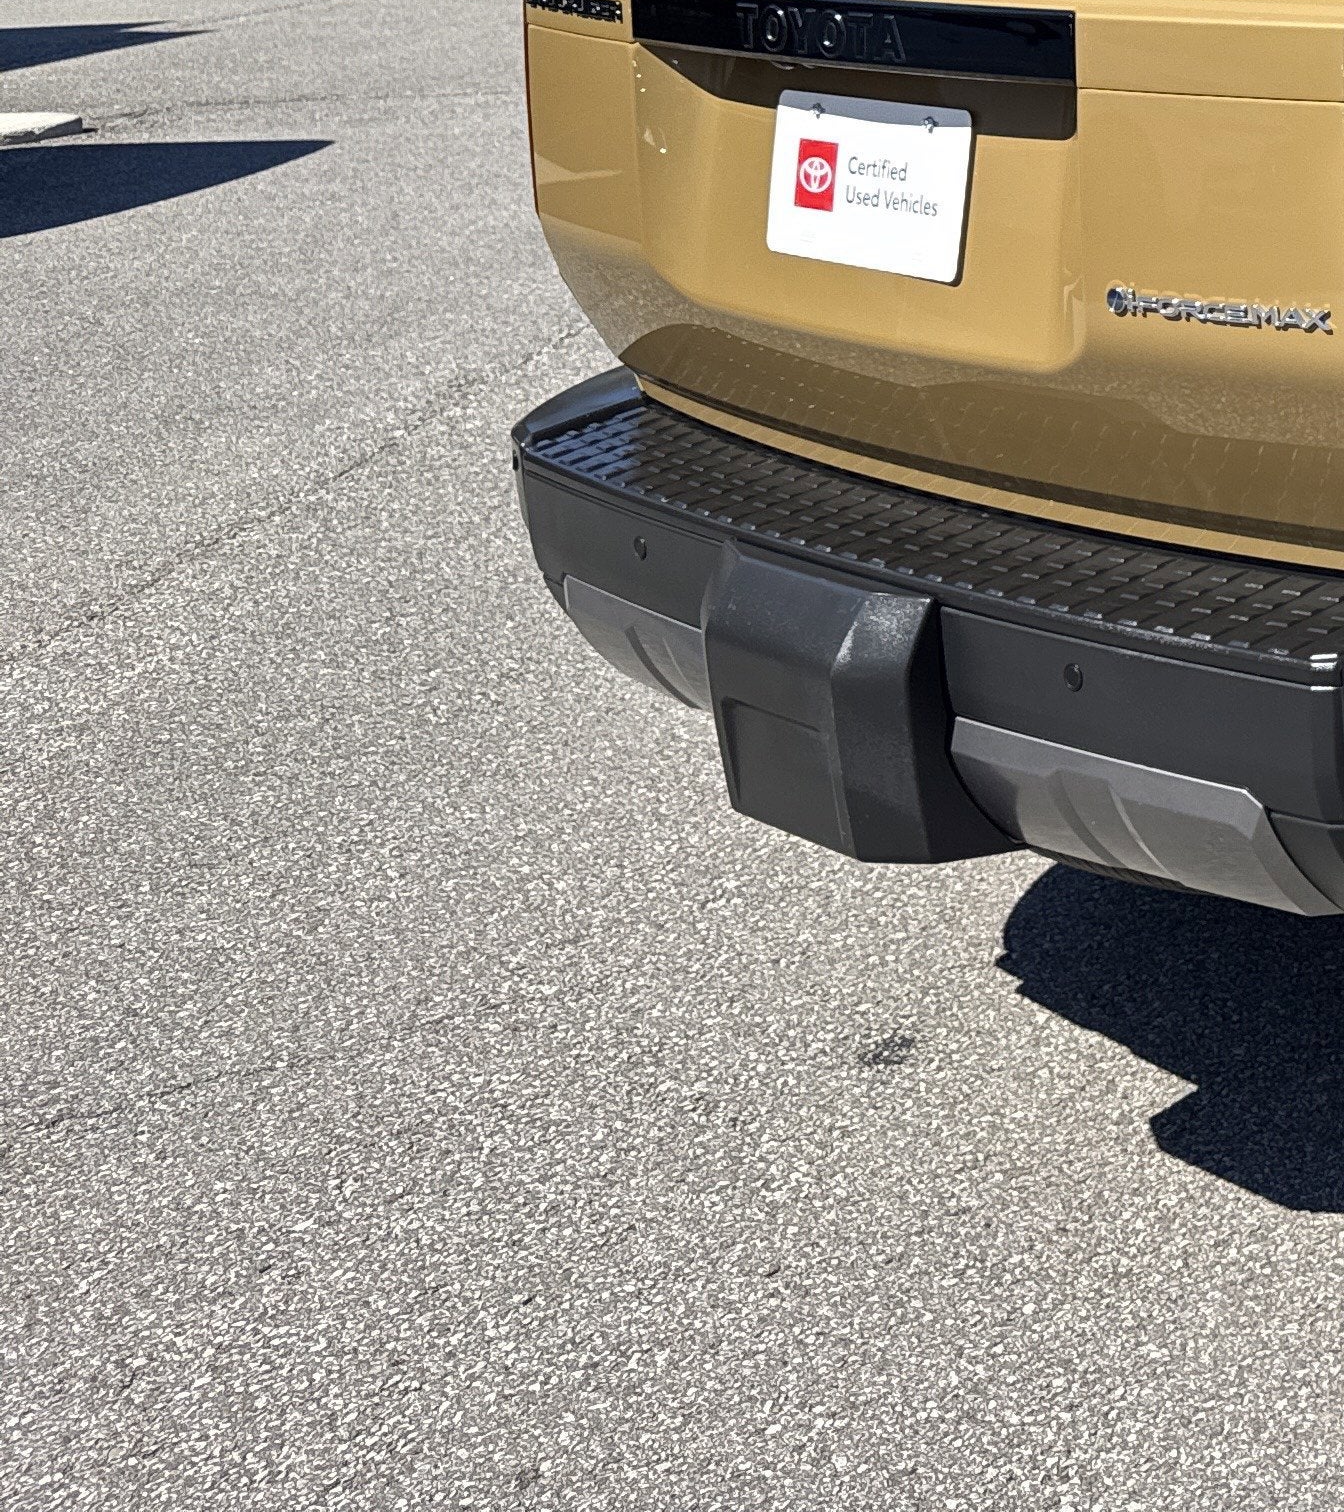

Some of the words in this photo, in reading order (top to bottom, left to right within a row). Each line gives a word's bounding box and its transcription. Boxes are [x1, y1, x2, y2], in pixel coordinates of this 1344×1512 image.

[735, 1, 907, 64] TOYOTA
[848, 156, 908, 181] Certified
[846, 185, 880, 207] Used
[884, 190, 938, 217] Vehicles
